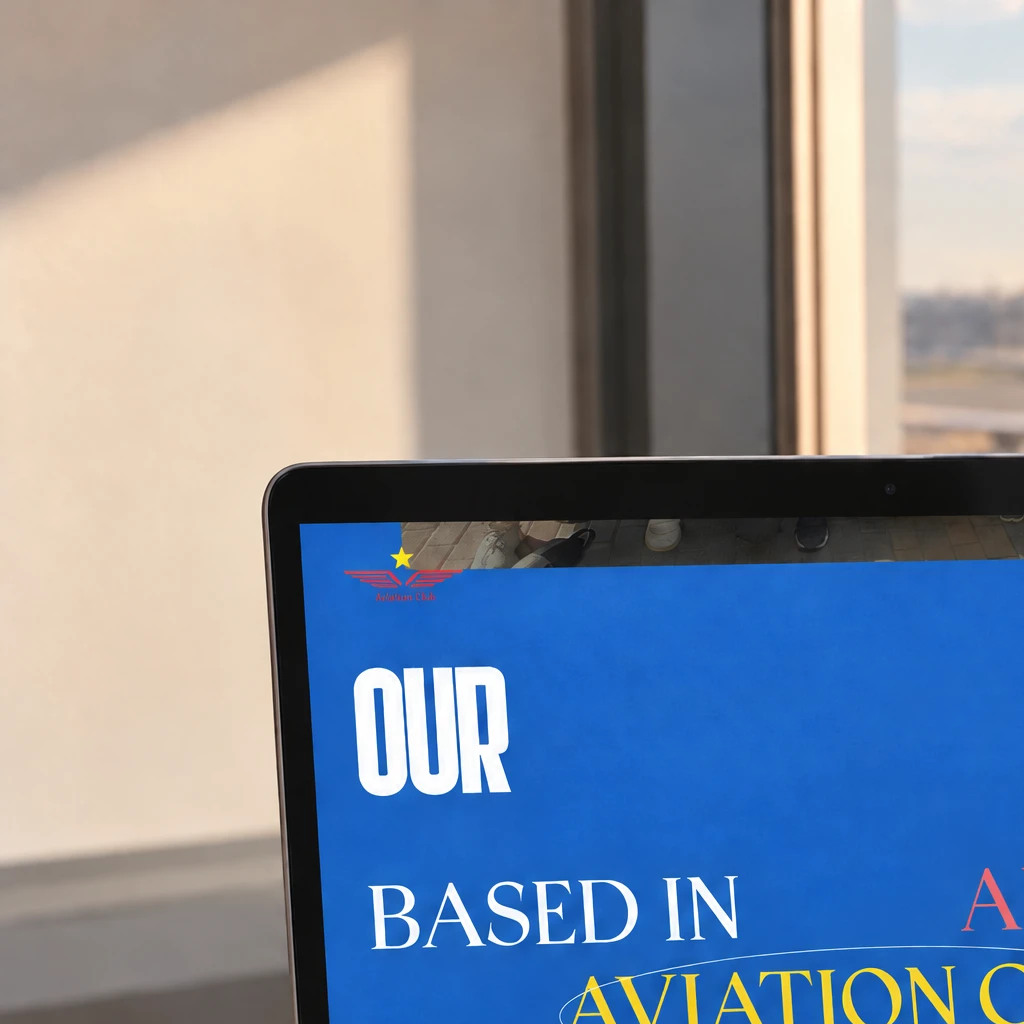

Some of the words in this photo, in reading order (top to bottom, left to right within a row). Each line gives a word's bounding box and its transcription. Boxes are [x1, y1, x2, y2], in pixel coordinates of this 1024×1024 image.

[353, 666, 512, 797] OUR
[368, 878, 639, 950] BASED
[662, 875, 739, 941] IN
